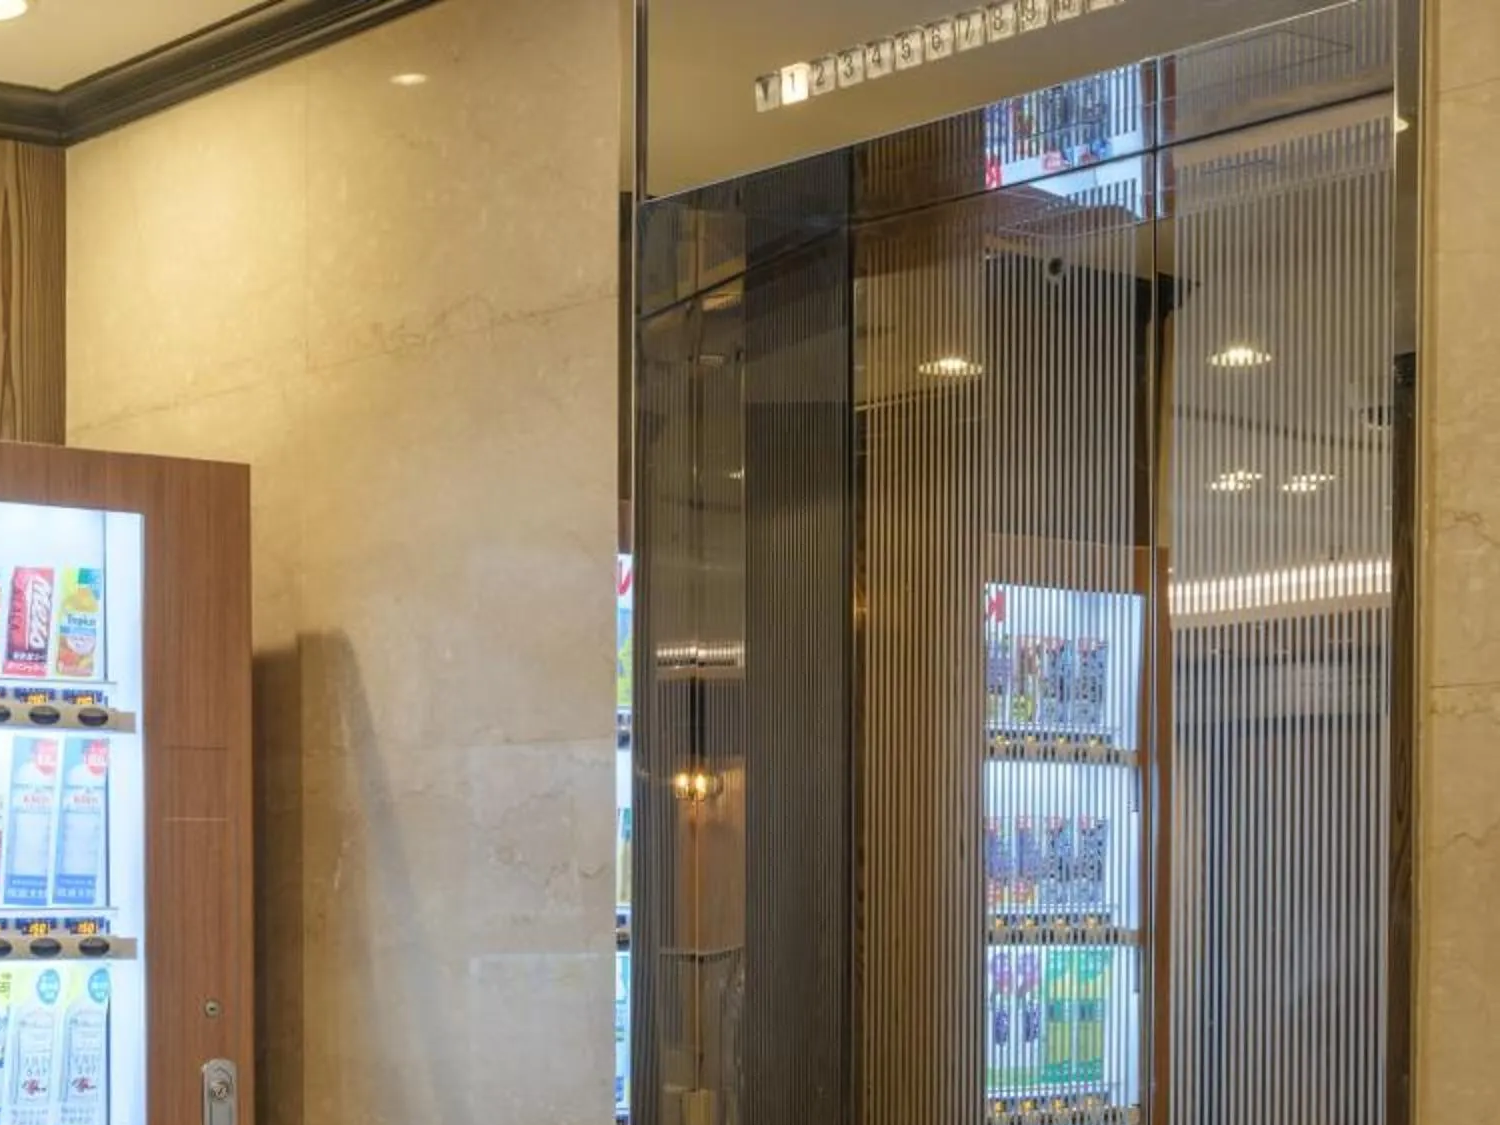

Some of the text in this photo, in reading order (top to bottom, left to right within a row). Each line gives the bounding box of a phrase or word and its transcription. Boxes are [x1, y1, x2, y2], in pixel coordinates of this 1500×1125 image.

[815, 62, 825, 87] 2
[843, 53, 854, 79] 3
[871, 42, 882, 66] 4
[901, 36, 912, 60] 5
[931, 26, 941, 51] 6
[993, 7, 1003, 31] 8
